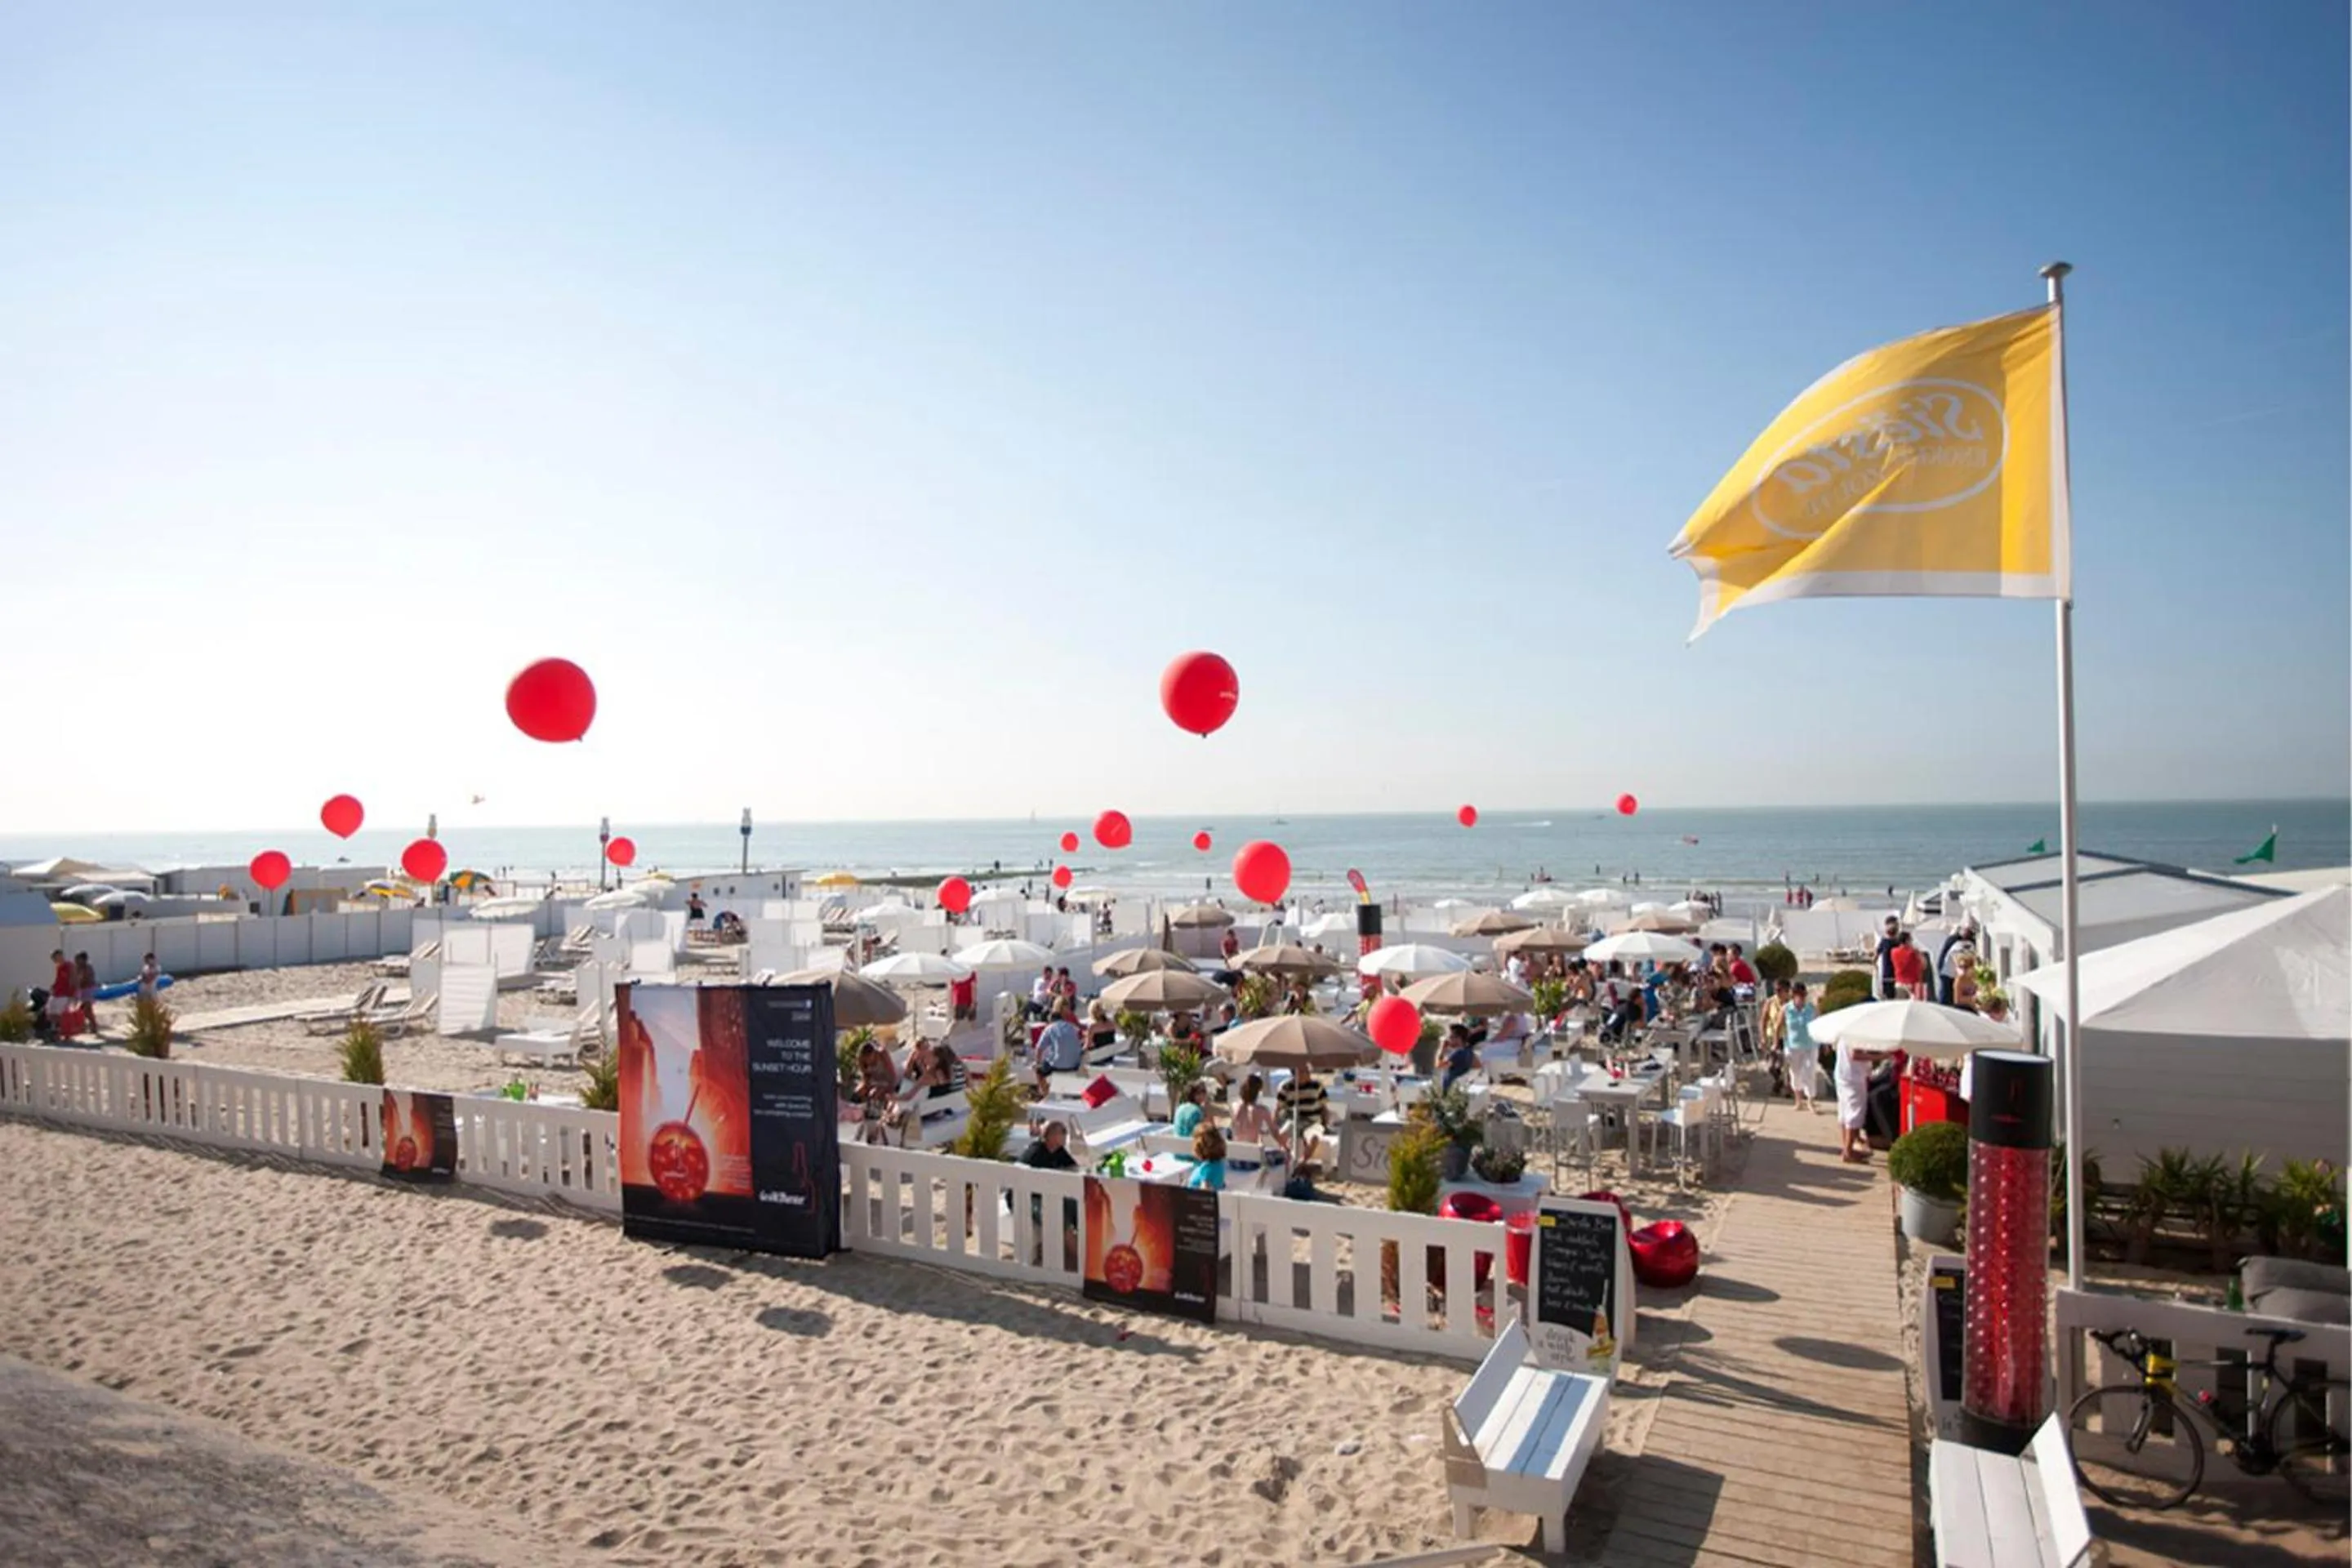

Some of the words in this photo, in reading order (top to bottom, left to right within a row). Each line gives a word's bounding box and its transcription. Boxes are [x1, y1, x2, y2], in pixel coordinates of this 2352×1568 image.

[766, 1039, 811, 1049] WELCOME
[782, 1050, 793, 1060] TO
[795, 1051, 811, 1061] THE
[752, 1062, 785, 1072] SUNSET
[786, 1063, 812, 1074] HOUR
